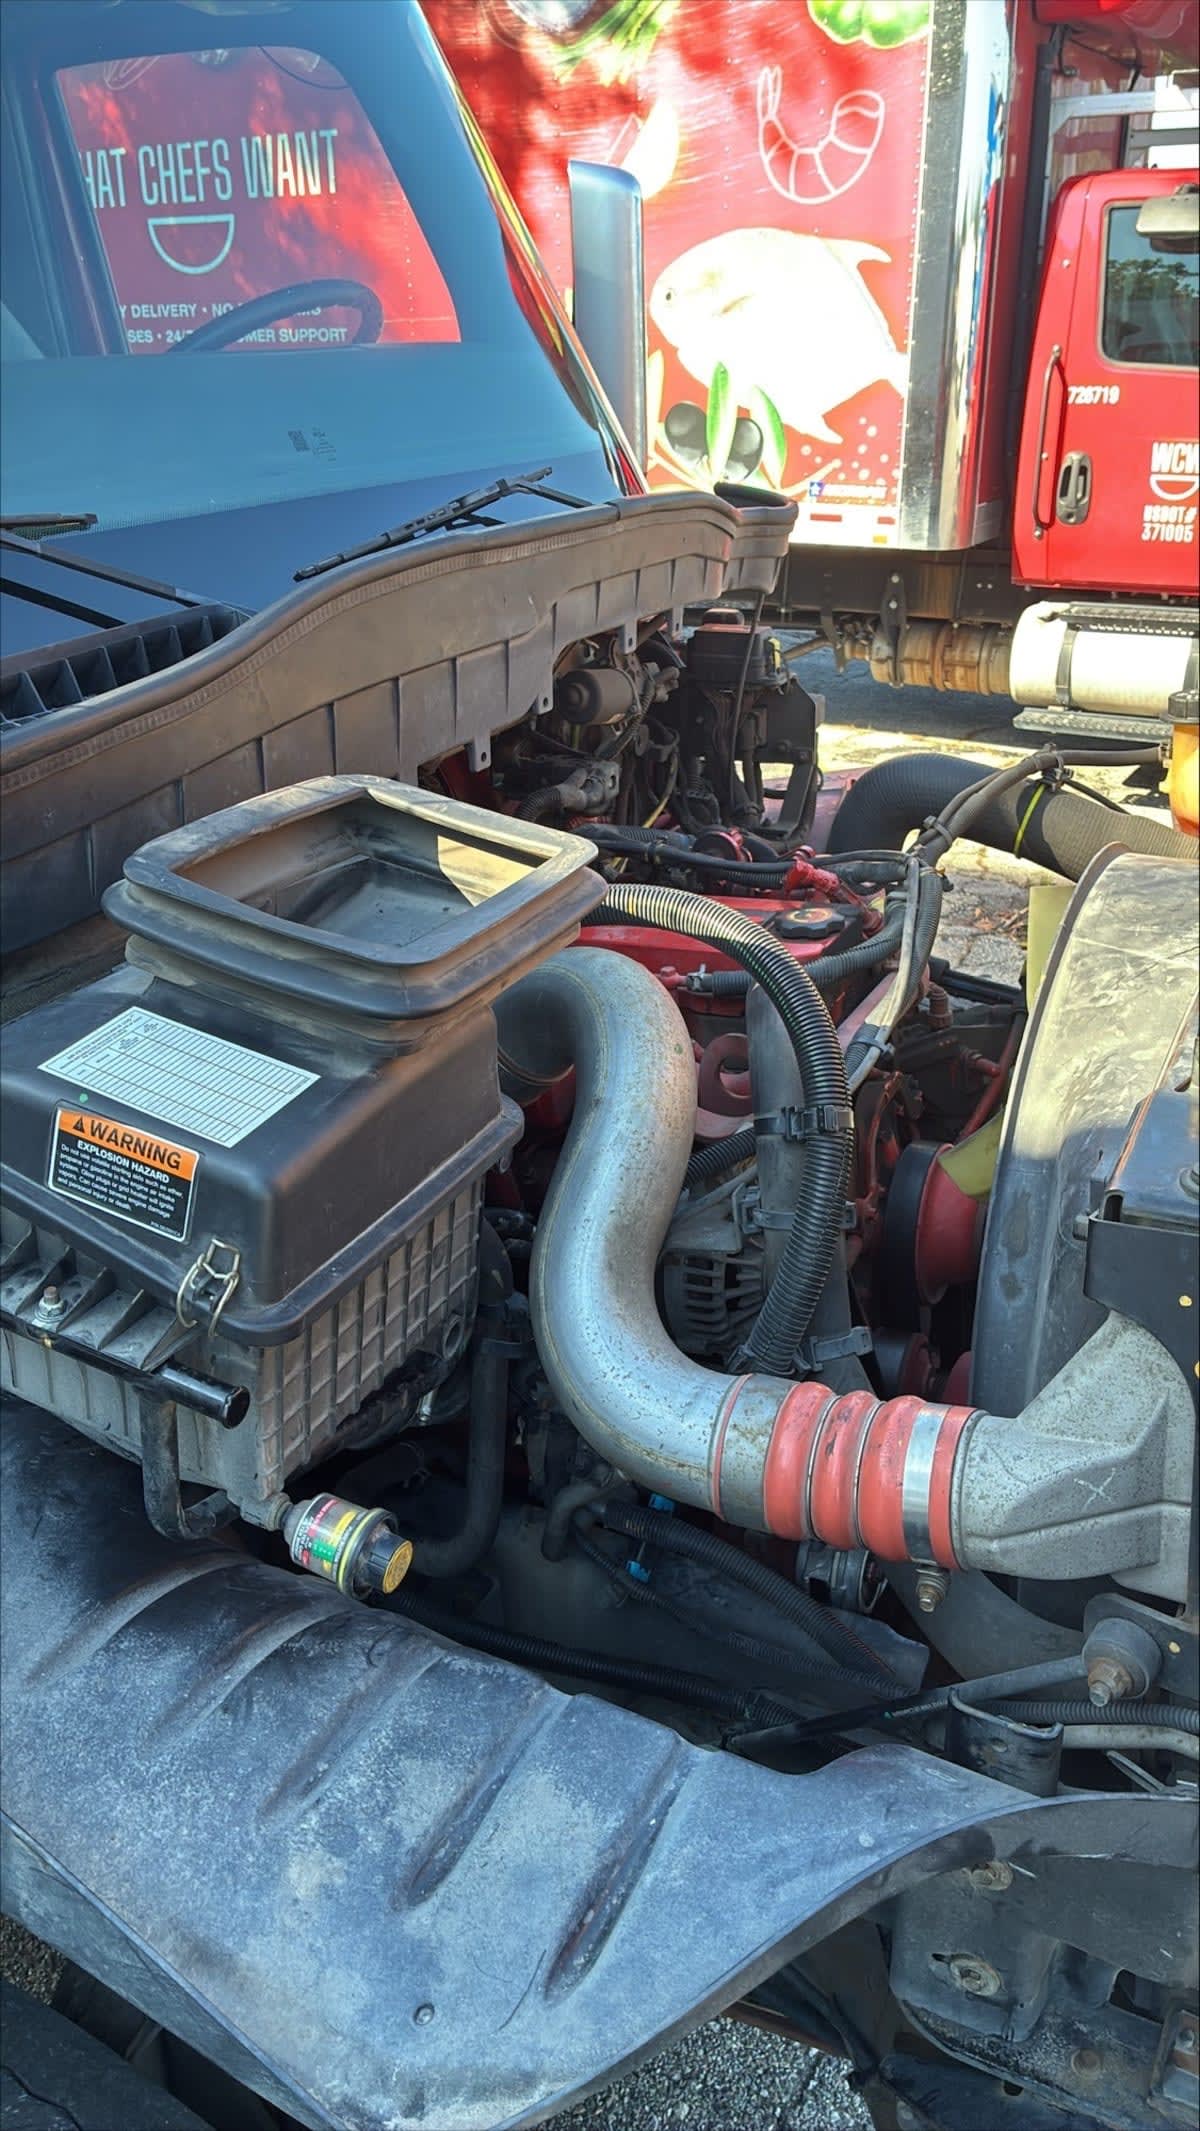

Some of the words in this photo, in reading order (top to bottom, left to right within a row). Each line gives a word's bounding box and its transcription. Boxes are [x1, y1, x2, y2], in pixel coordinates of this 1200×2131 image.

[79, 147, 126, 208] HAT
[138, 138, 233, 206] CHEFS
[241, 128, 338, 198] WANT
[131, 303, 197, 318] DELIVERY
[127, 329, 153, 343] SES
[166, 329, 194, 342] 24/
[279, 328, 348, 343] SUPPORT
[1141, 523, 1194, 542] 371005
[90, 1119, 182, 1171] WARNING
[77, 1140, 130, 1168] EXPLOSION
[131, 1161, 170, 1183] HAZARD
